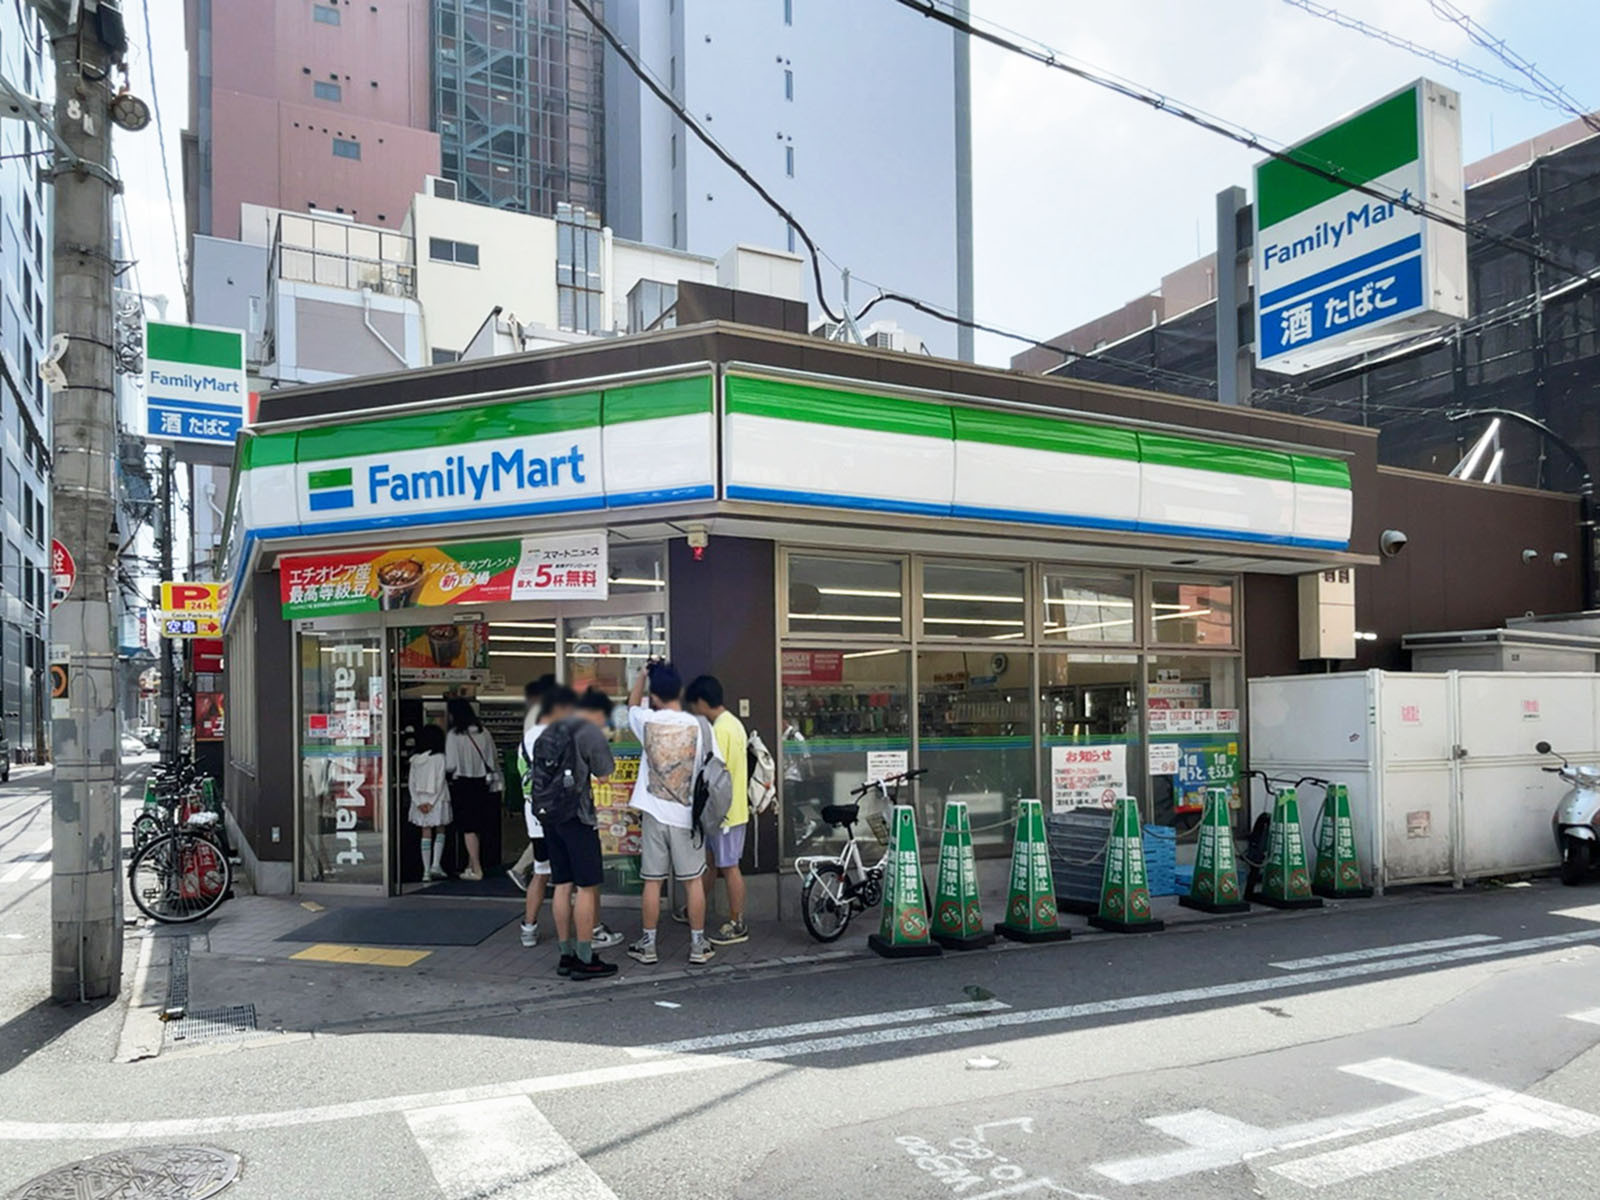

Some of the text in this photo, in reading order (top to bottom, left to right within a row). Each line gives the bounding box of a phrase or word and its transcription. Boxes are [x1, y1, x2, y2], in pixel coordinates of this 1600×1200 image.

[1280, 275, 1398, 346] 酒 たばこ
[150, 370, 239, 393] FamilyMart
[161, 411, 231, 437] 酒 たばこ
[369, 444, 586, 504] FamilyMart
[543, 547, 600, 560] スマートニュース
[289, 562, 372, 584] エチオピア産
[172, 586, 211, 609] P
[1065, 749, 1112, 763] お知らせ
